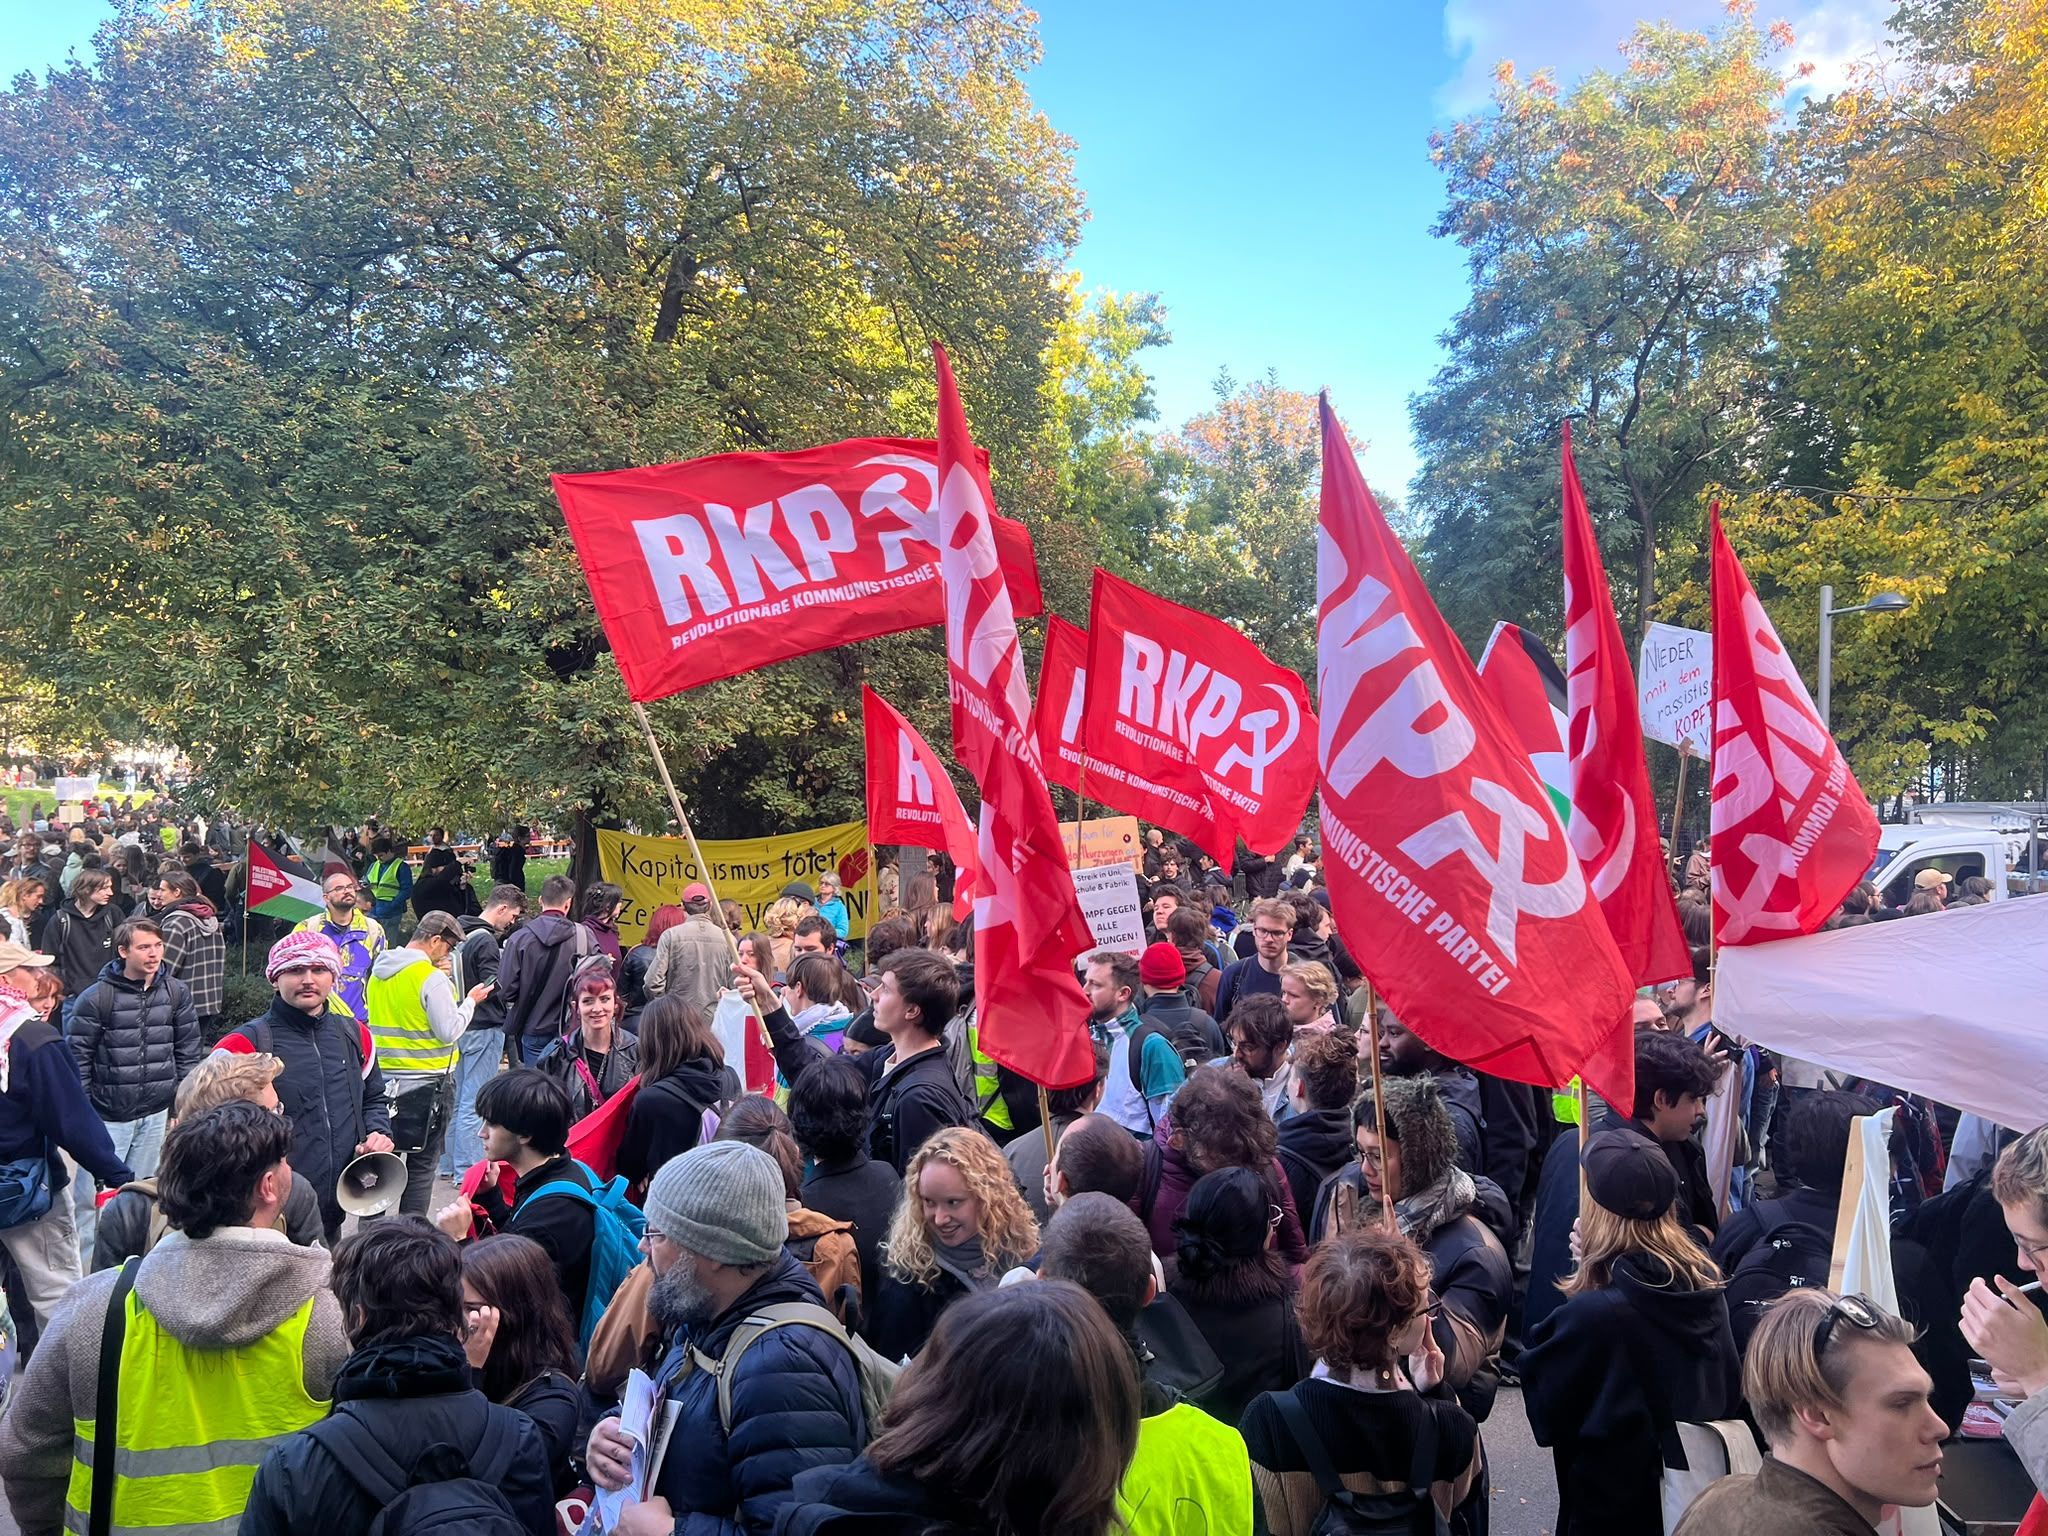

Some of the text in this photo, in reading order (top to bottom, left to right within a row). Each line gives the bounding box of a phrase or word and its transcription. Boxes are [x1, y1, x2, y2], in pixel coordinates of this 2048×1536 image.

[632, 483, 857, 626] RKP
[672, 563, 935, 650] REVOLUTIONÄRE KOMMUNISTISCHE
[1645, 637, 1694, 679] NIEDER
[1118, 630, 1243, 756] RKP
[1644, 666, 1701, 704] mit dem
[1657, 680, 1710, 722] rassistis
[1115, 720, 1184, 763] REVOLUTIONÄRE
[1126, 773, 1202, 811] KOMMUNISTISCHE
[896, 807, 942, 824] REVOLUTIO
[621, 842, 838, 887] Kapitaismus tötet
[1076, 872, 1098, 882] Streik
[1099, 871, 1107, 879] in
[1097, 883, 1104, 891] &
[1085, 903, 1137, 919] MPF GEGEN
[1097, 920, 1118, 932] ALLE
[1425, 911, 1511, 996] PARTEI
